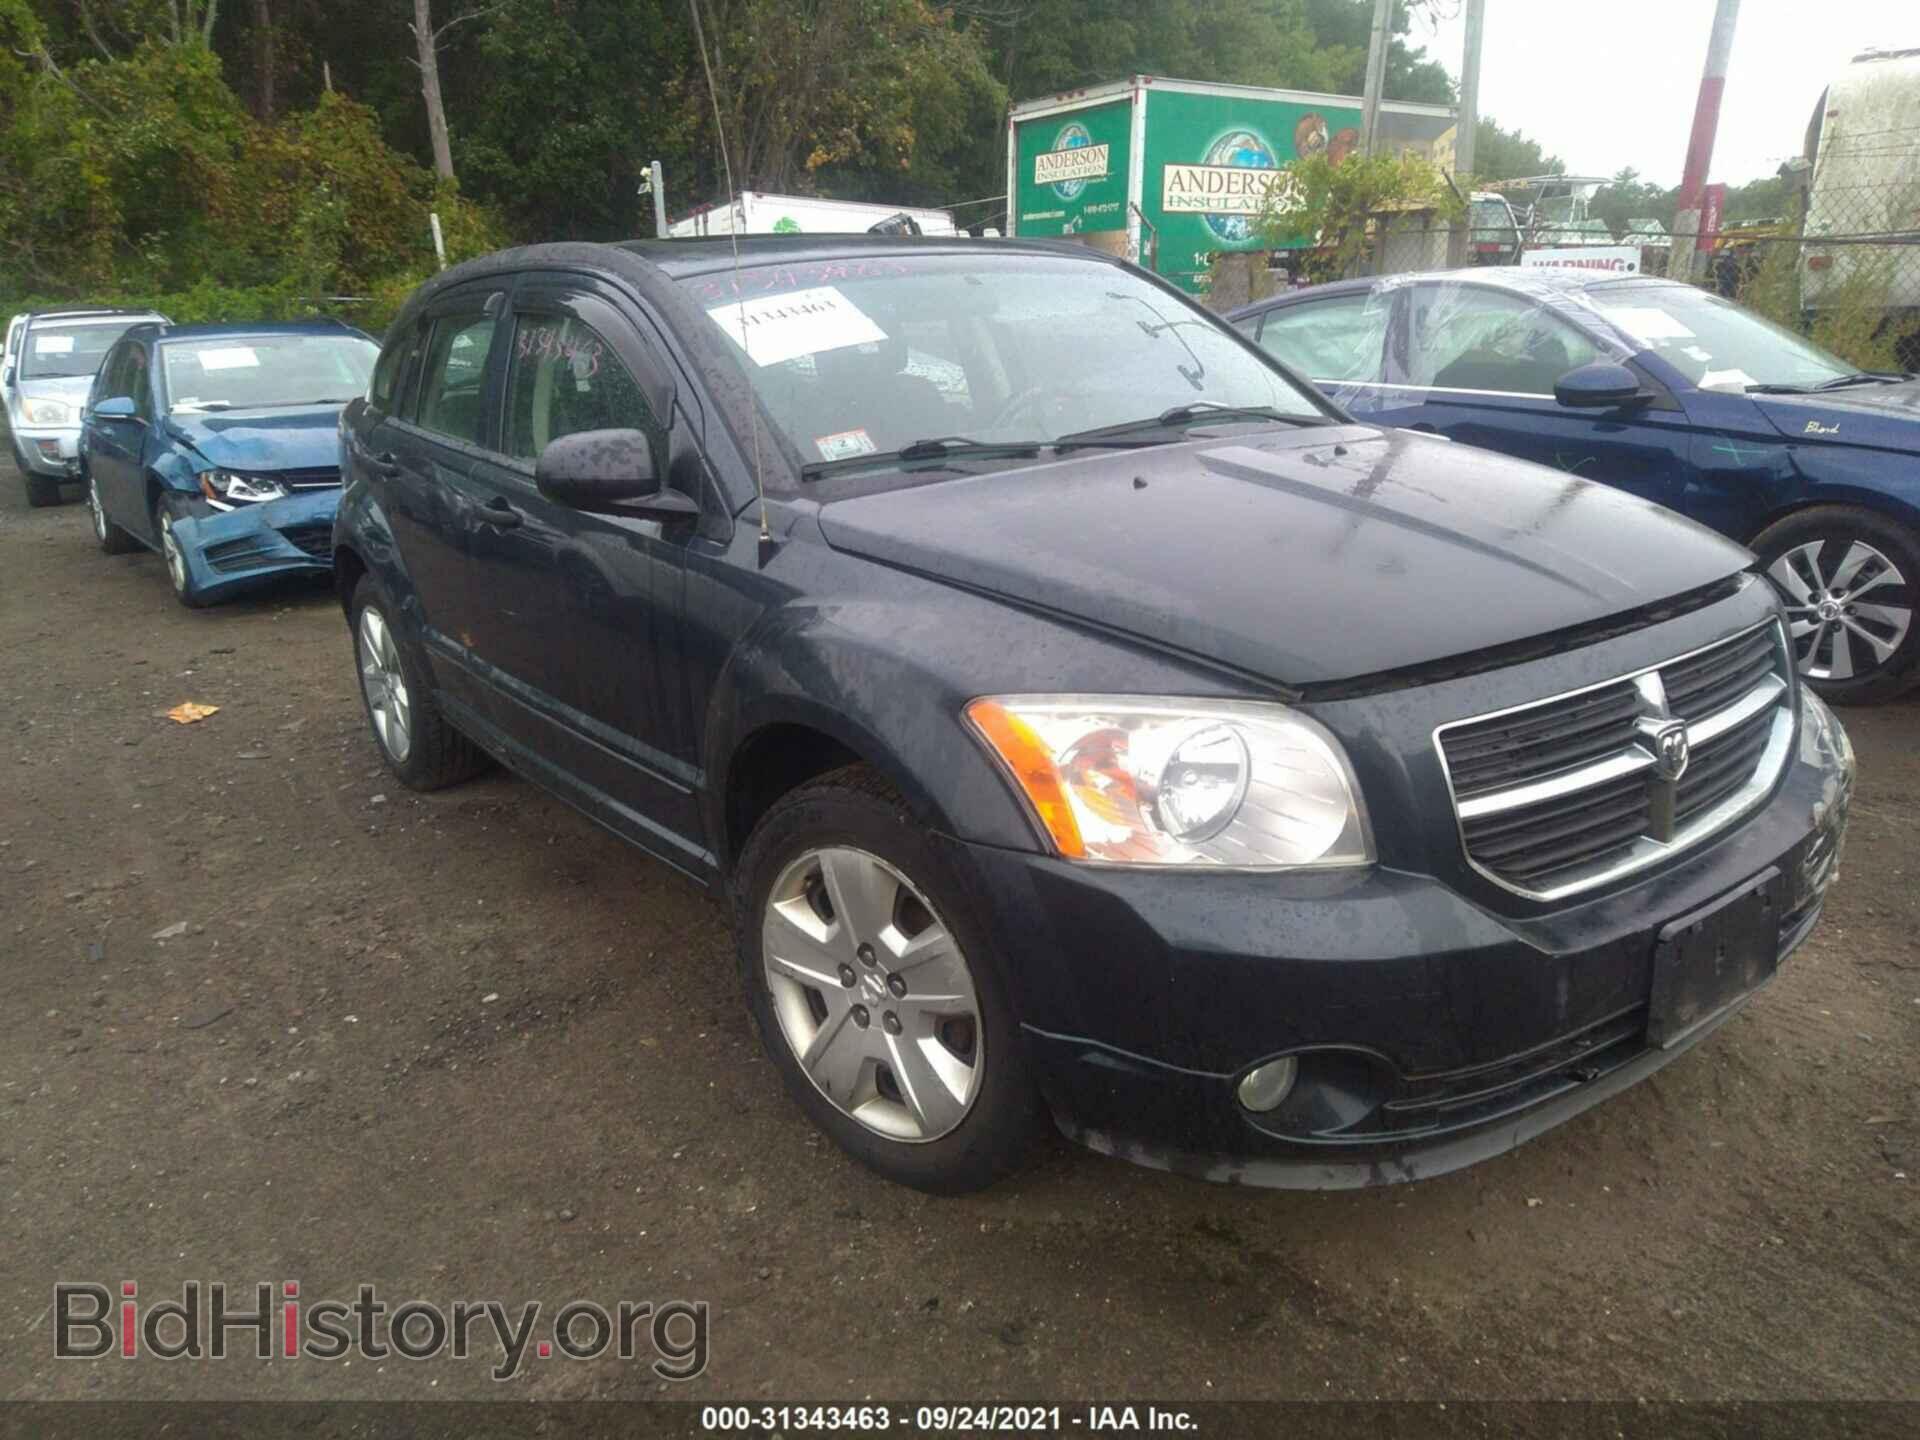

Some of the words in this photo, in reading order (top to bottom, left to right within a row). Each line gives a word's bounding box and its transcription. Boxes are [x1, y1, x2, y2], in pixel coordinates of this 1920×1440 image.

[1038, 147, 1106, 171] ANDERSON
[1038, 165, 1105, 180] INSULATION
[1168, 195, 1302, 211] INSULATO
